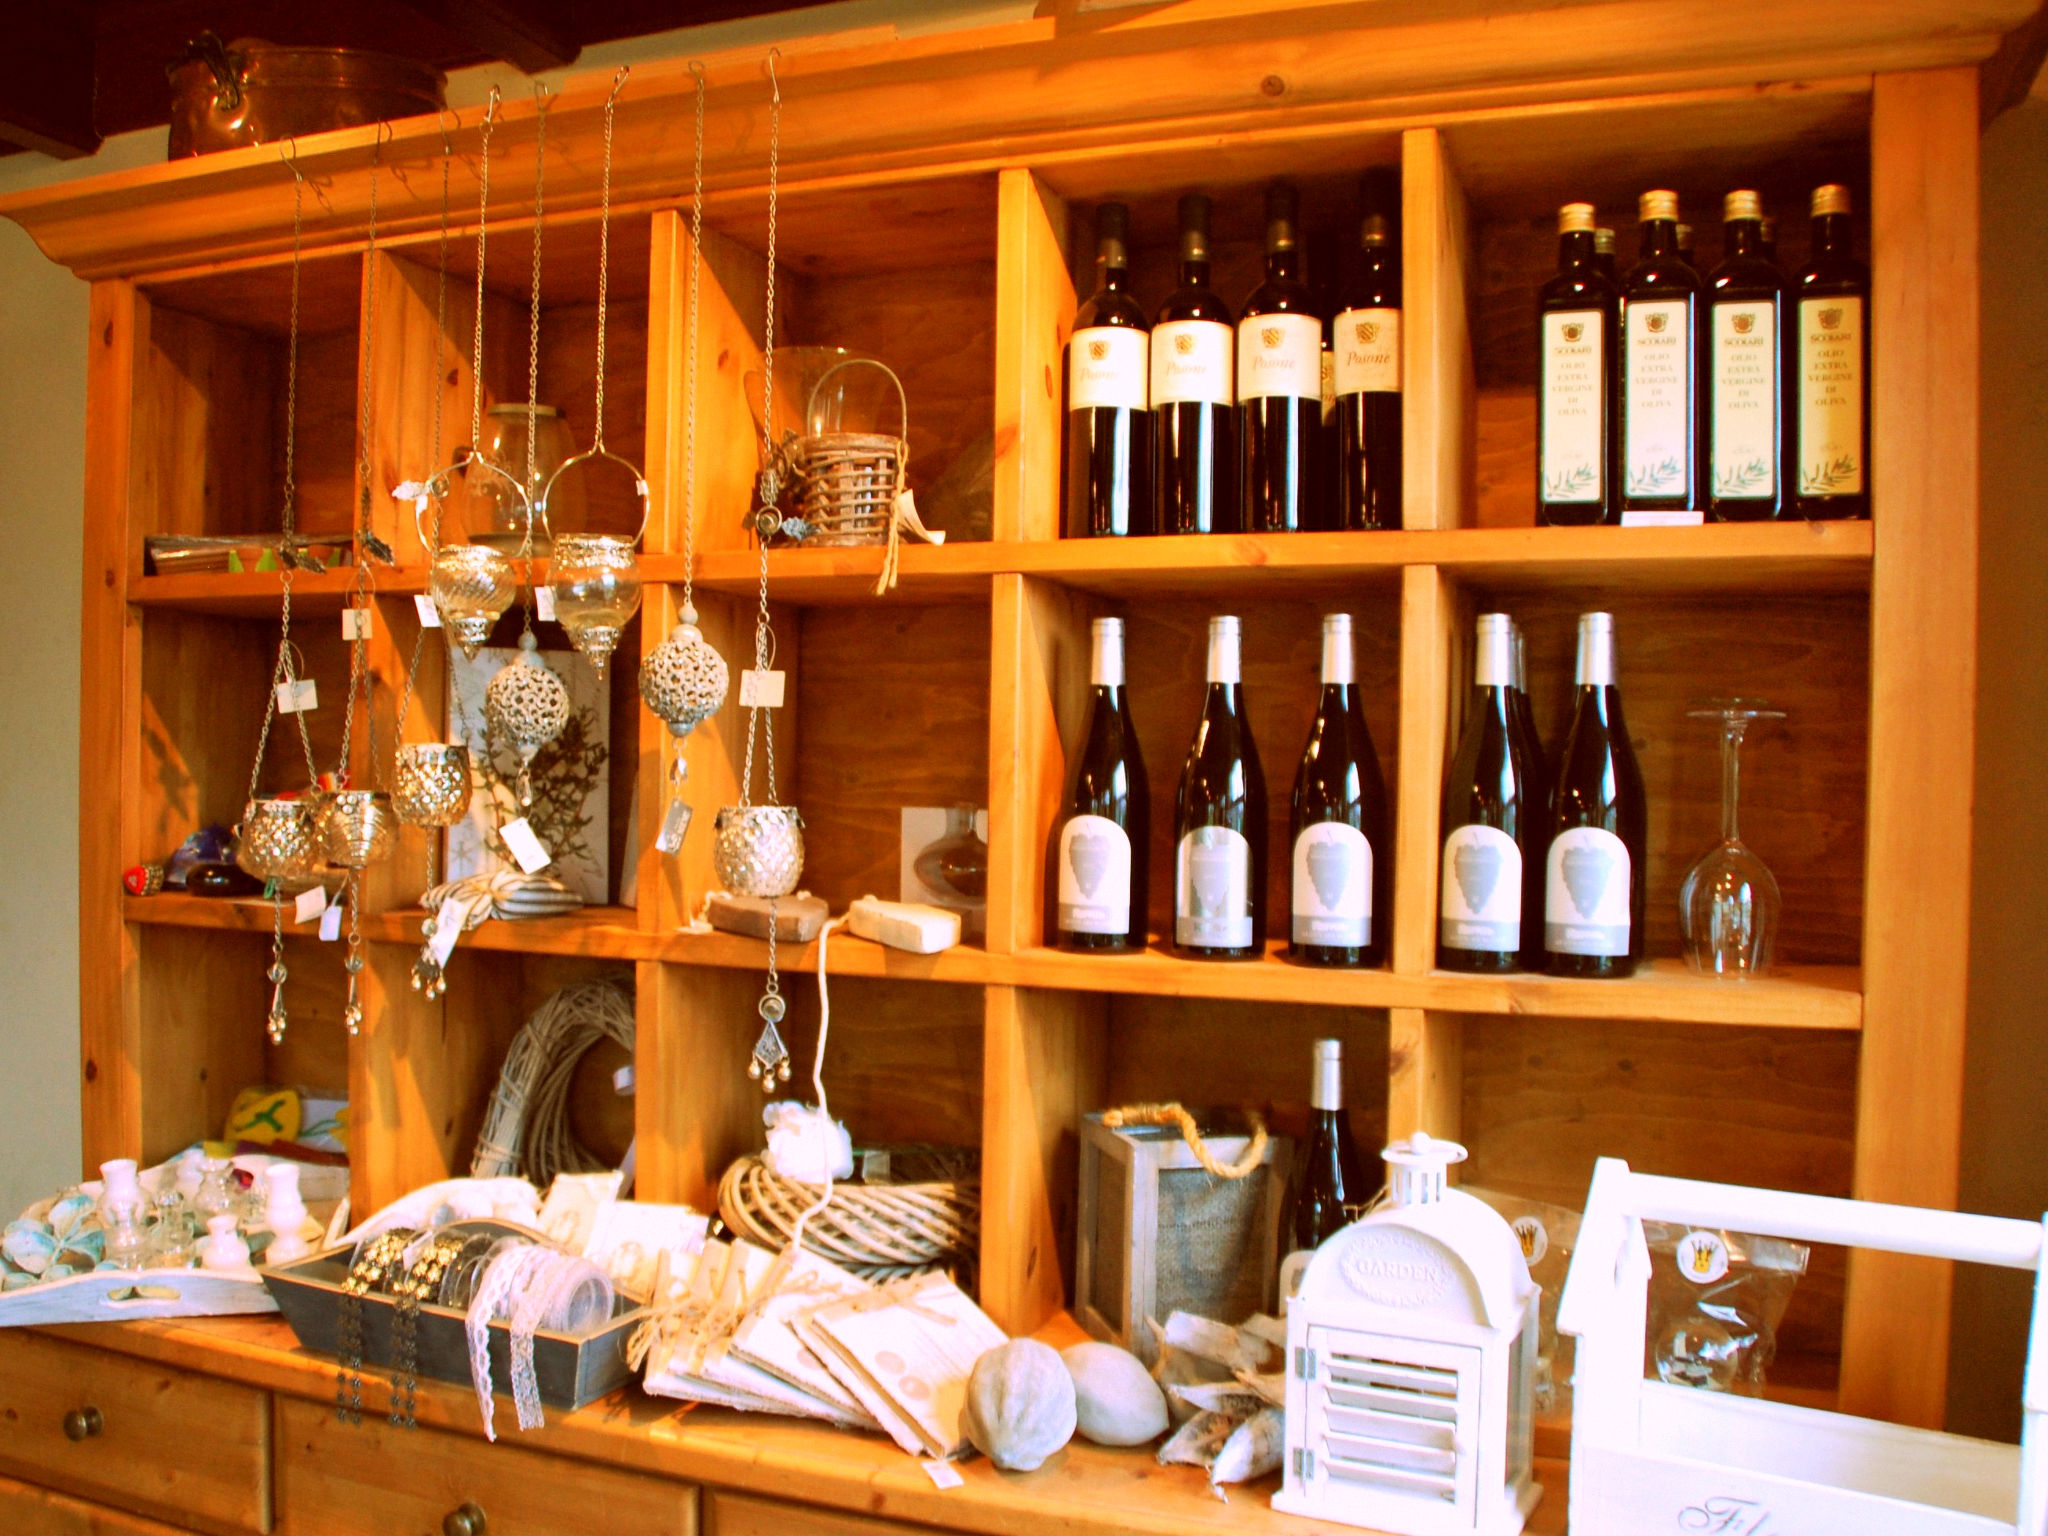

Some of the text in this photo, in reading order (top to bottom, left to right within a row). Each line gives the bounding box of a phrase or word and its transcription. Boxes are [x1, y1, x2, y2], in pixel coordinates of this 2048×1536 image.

[1644, 353, 1670, 361] OLIO
[1731, 353, 1758, 362] OLIO
[1817, 349, 1845, 358] OLIO
[1560, 362, 1586, 370] OLIO
[1640, 364, 1673, 373] EXTRA
[1727, 365, 1761, 374] EXTRA
[1814, 361, 1848, 370] EXTRA
[1557, 373, 1588, 381] EXTRA
[1634, 376, 1678, 385] VERGINE
[1721, 377, 1767, 385] VERGINE
[1808, 373, 1853, 382] VERGINE
[1552, 384, 1593, 392] VERGINE
[1825, 385, 1837, 393] DI
[1641, 399, 1672, 408] OLIVA
[1728, 400, 1759, 409] OLIVA
[1814, 397, 1847, 406] OLIVA
[1558, 407, 1587, 416] OLIVA
[1356, 1258, 1437, 1282] GARDEN
[1678, 1496, 1778, 1536] Fl
